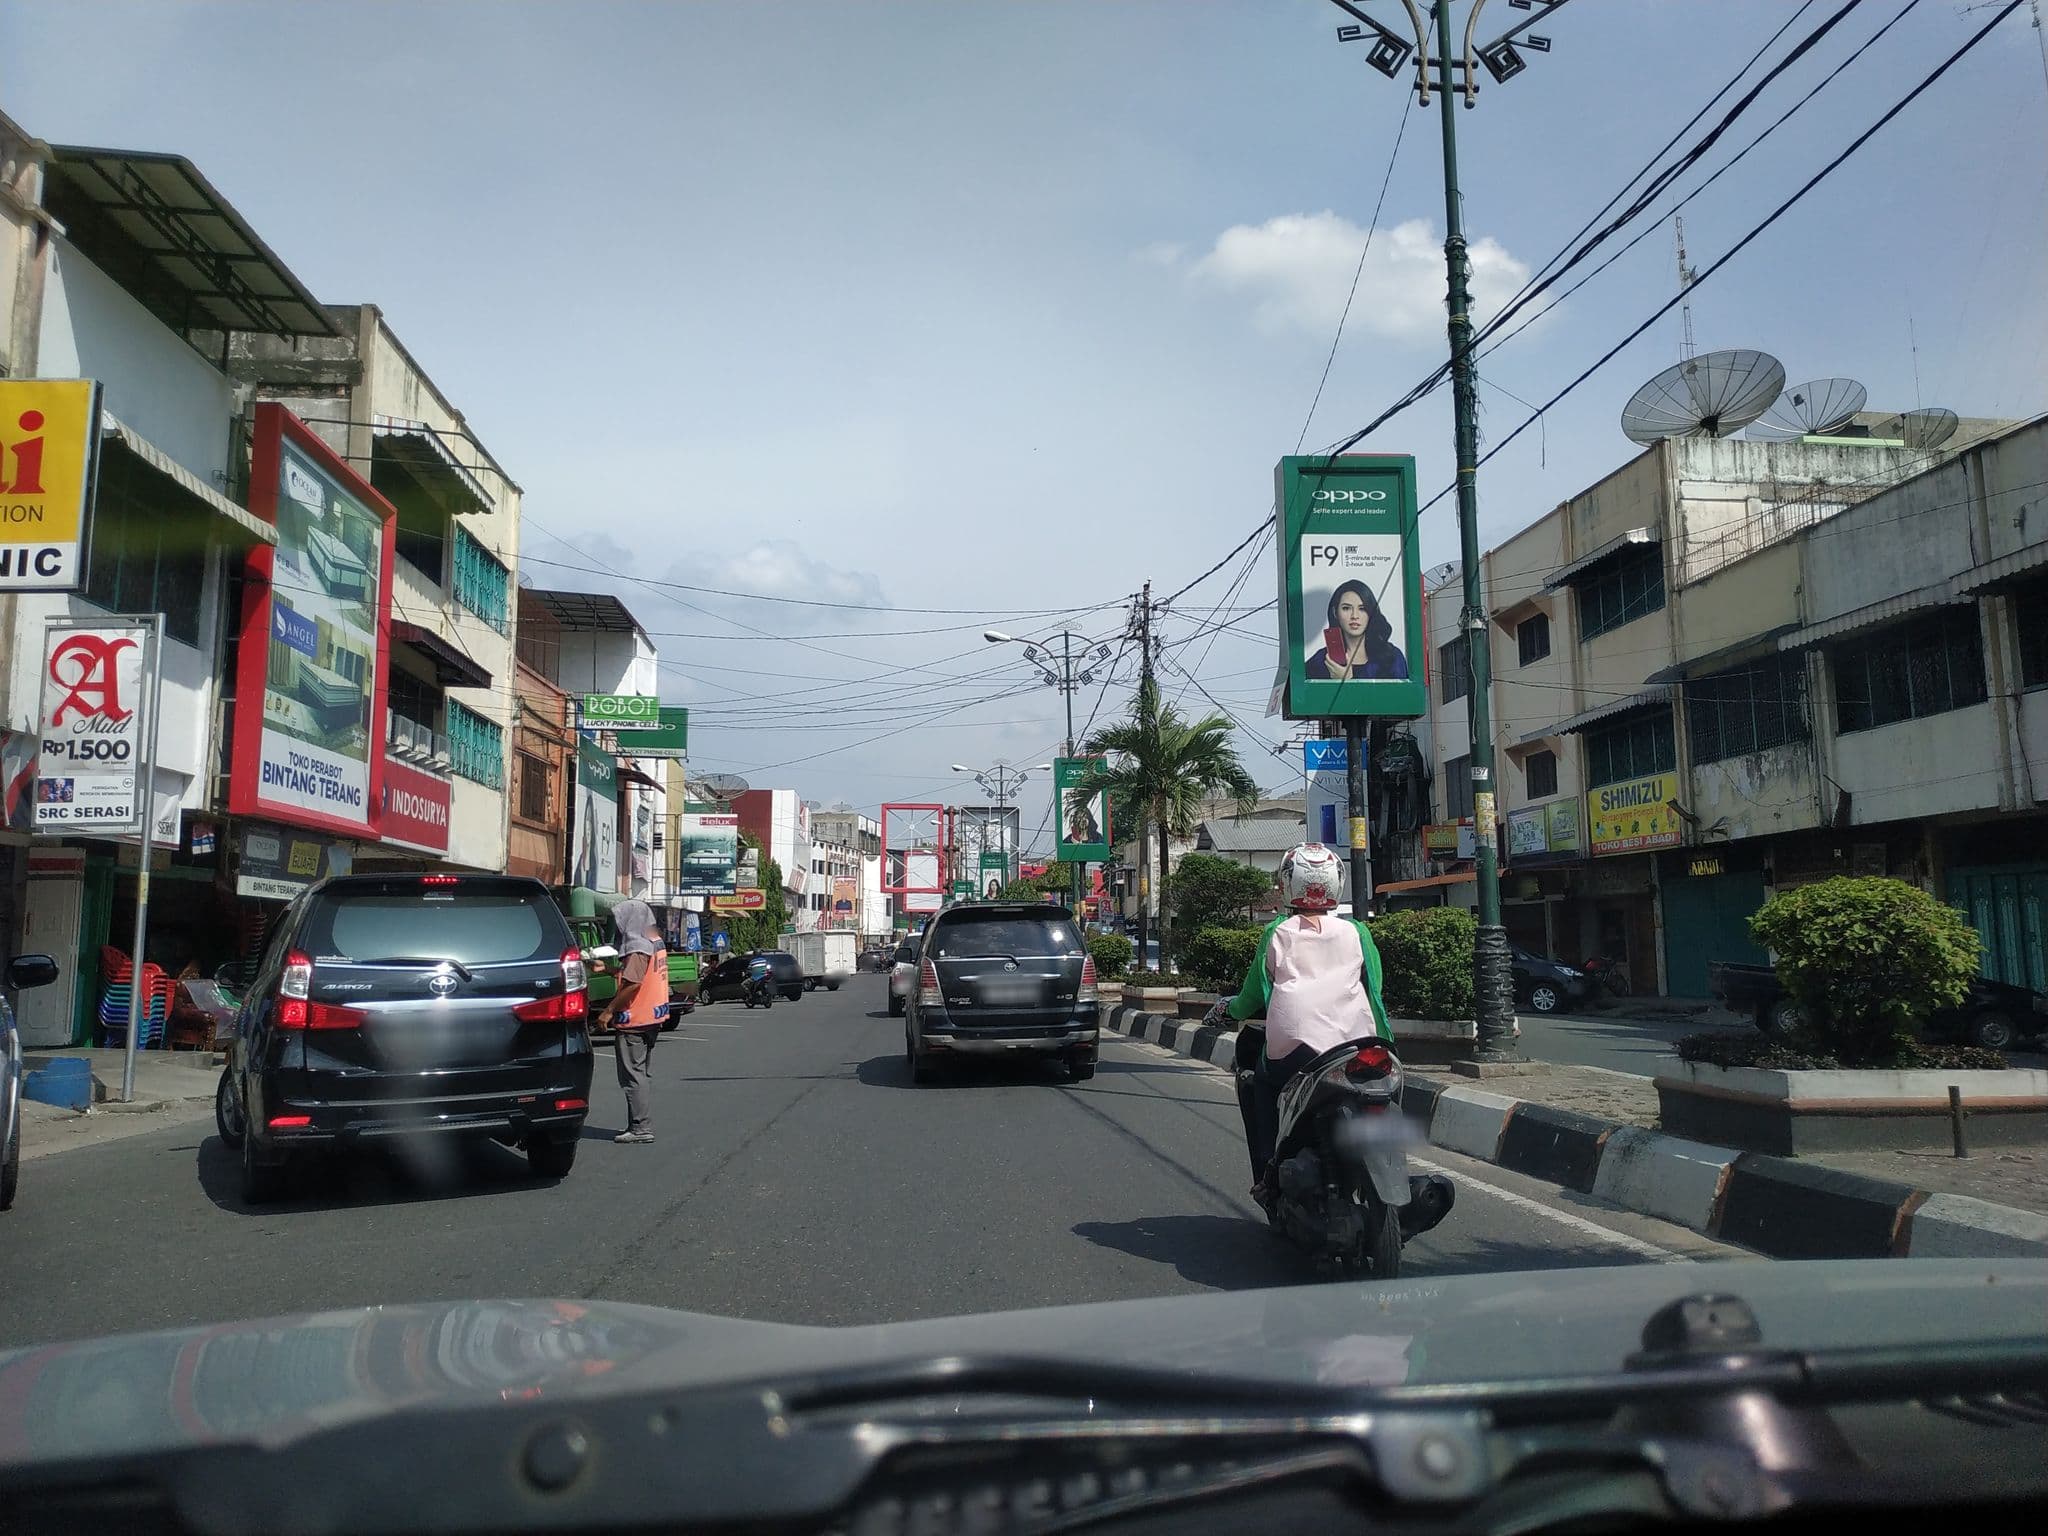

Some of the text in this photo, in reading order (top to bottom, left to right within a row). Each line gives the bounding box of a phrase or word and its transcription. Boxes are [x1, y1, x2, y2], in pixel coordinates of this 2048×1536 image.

[1312, 490, 1386, 503] oppo
[0, 504, 44, 523] ION
[1331, 508, 1352, 516] expert
[1311, 545, 1339, 567] F9
[286, 621, 315, 647] ANGEL
[50, 634, 139, 727] A
[590, 697, 654, 715] ROBOT
[72, 712, 133, 734] Mild
[288, 751, 343, 781] TOKO PERABOT
[262, 761, 361, 807] BINTANG TERANG
[1600, 779, 1663, 812] SHIMIZU
[39, 806, 129, 818] SRC SERASI
[392, 788, 447, 827] INDOSURYA
[1596, 833, 1675, 851] TOKO BESI ABADI
[253, 881, 297, 895] BINTANG TERANG
